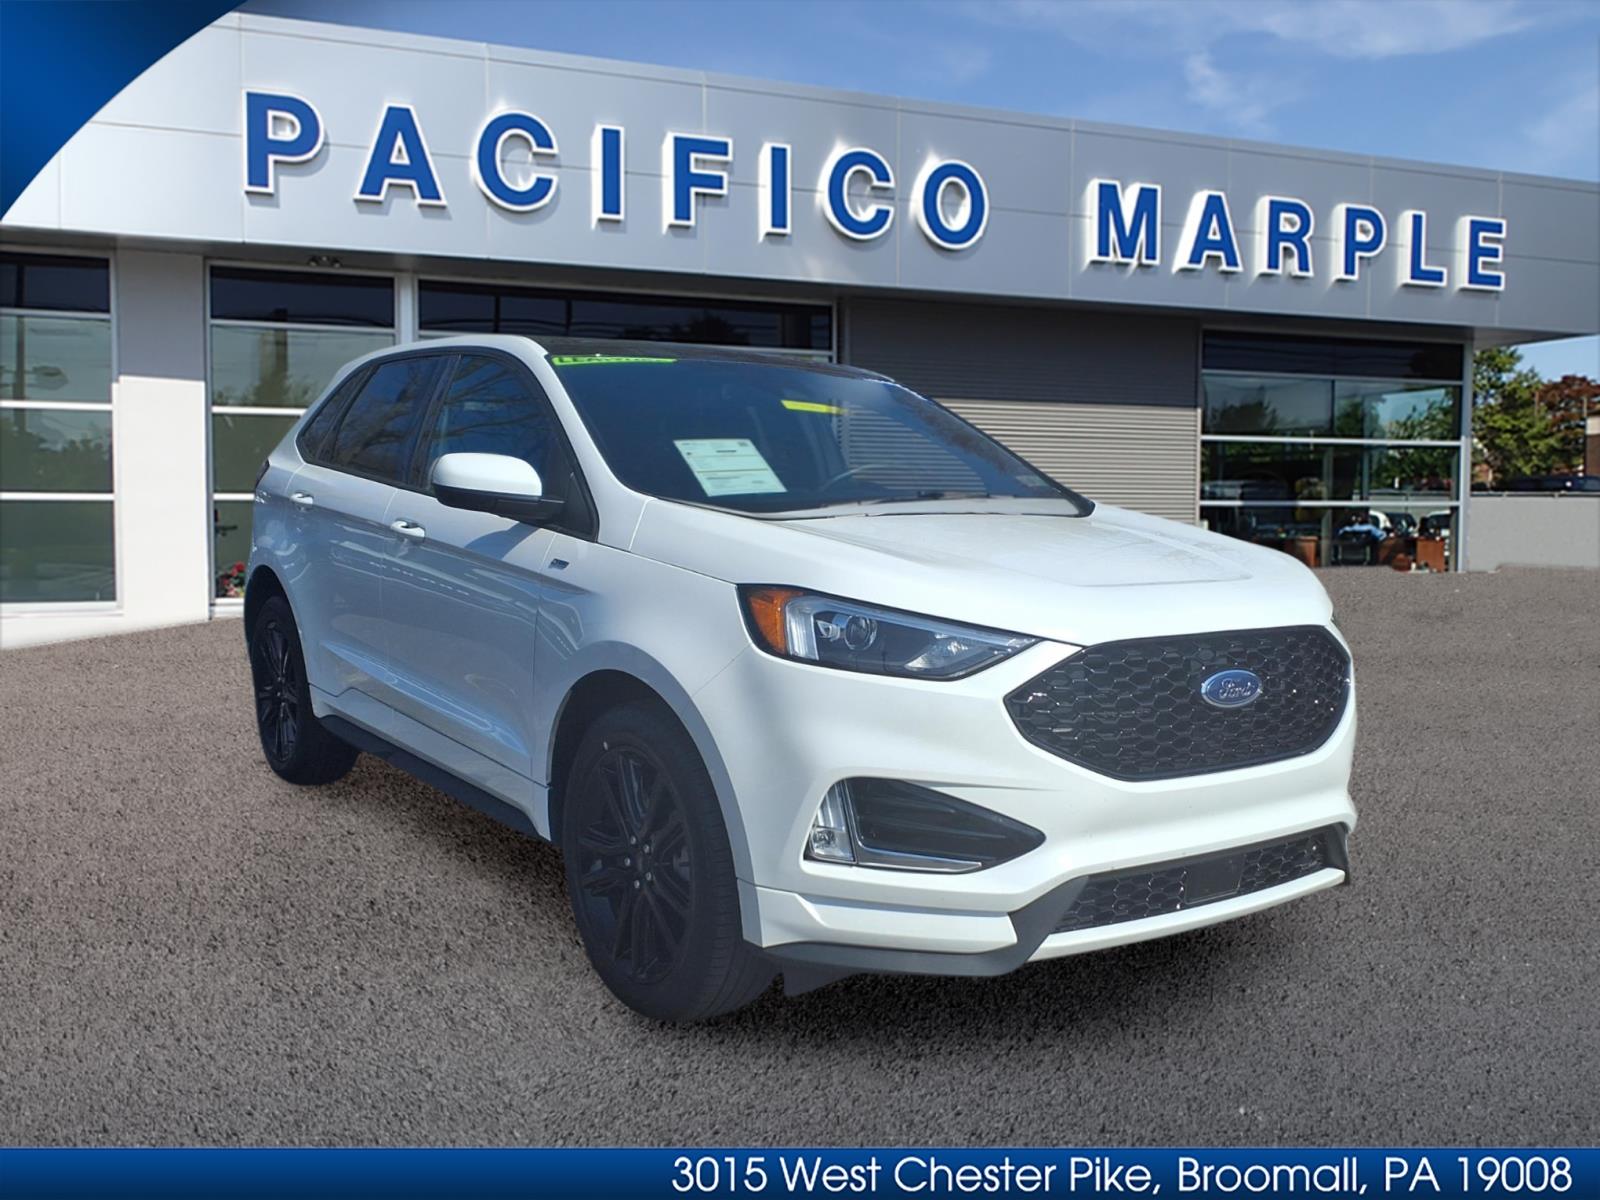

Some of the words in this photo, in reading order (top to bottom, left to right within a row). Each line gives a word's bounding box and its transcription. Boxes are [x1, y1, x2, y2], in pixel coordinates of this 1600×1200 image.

[242, 88, 989, 250] PACIFICO
[1086, 178, 1508, 291] MARPLE
[1219, 678, 1252, 699] Ford
